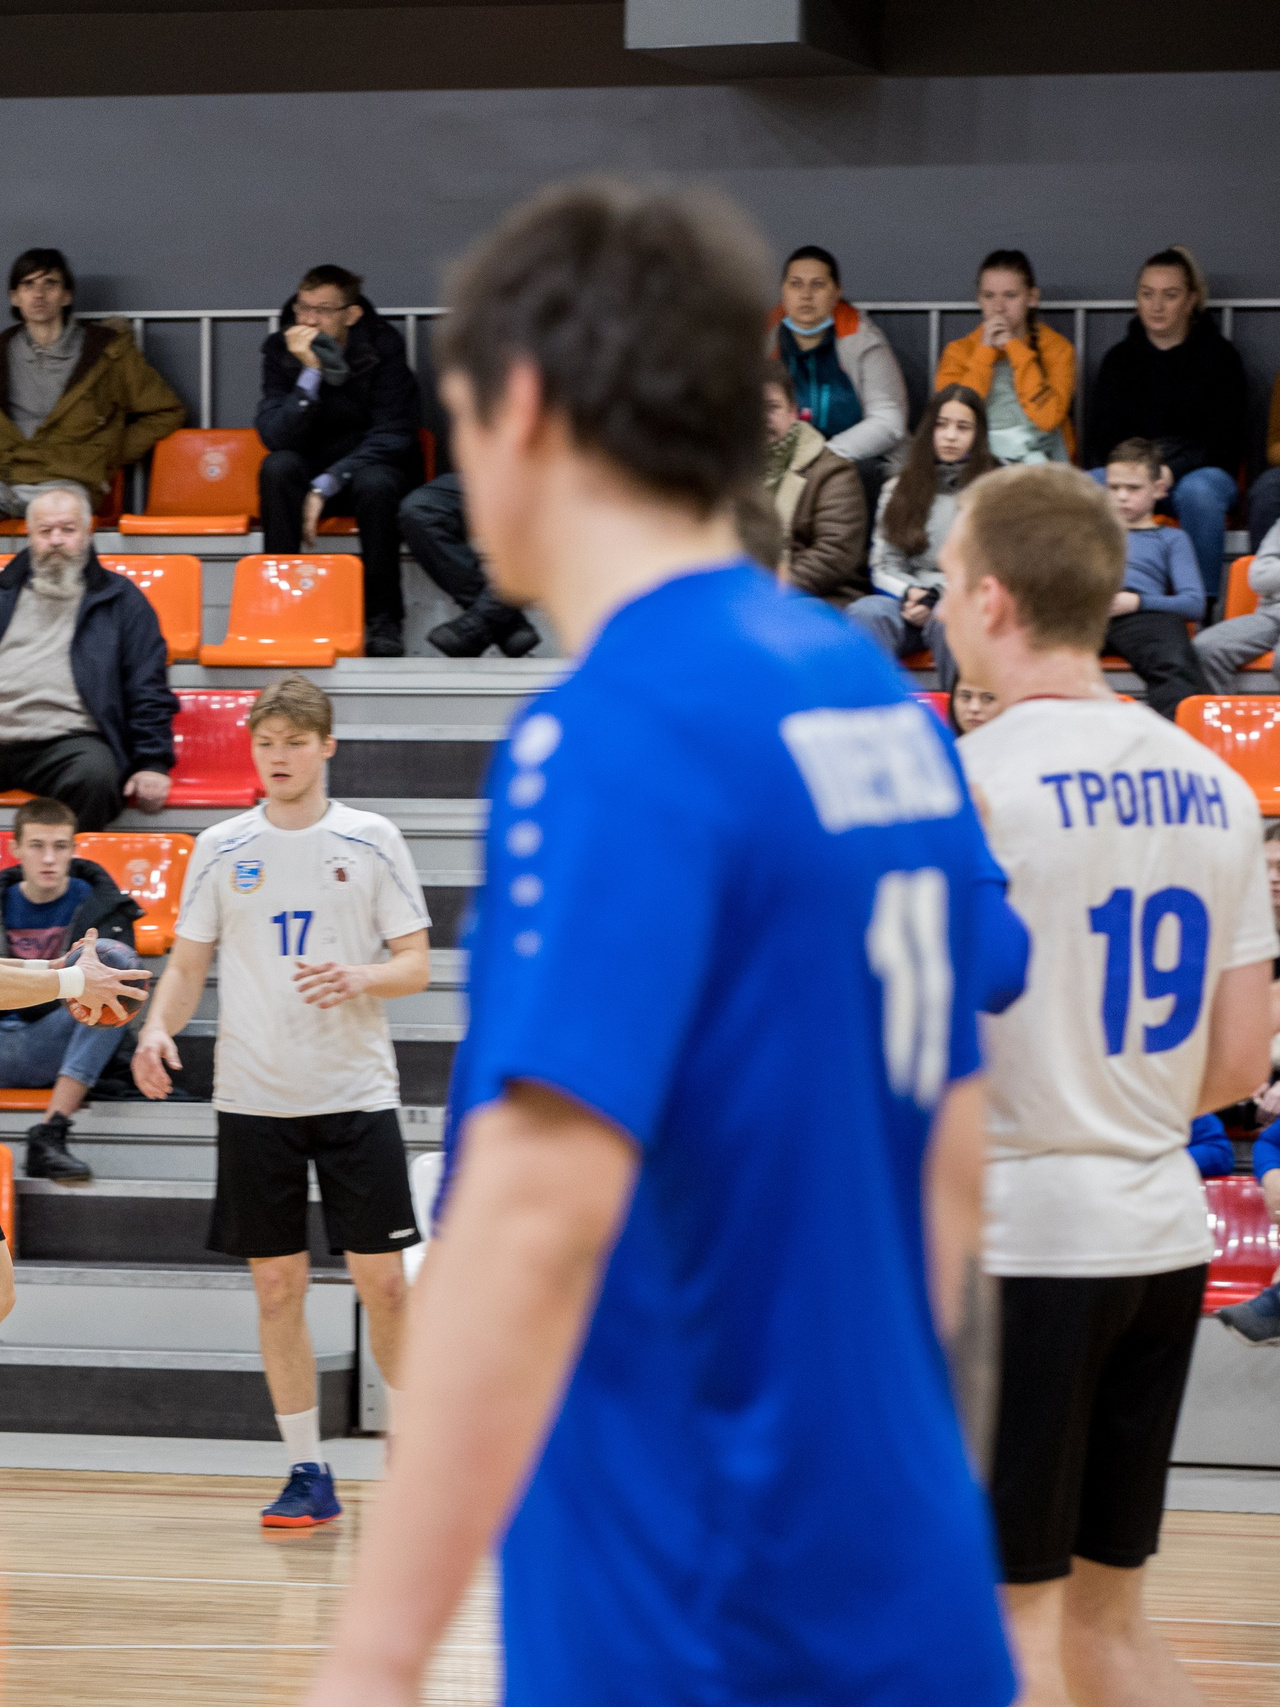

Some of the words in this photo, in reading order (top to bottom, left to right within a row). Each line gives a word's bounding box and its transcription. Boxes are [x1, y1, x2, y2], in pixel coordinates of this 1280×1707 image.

[1040, 768, 1229, 830] ТРОПИН
[271, 910, 314, 956] 17
[1087, 885, 1211, 1057] 19
